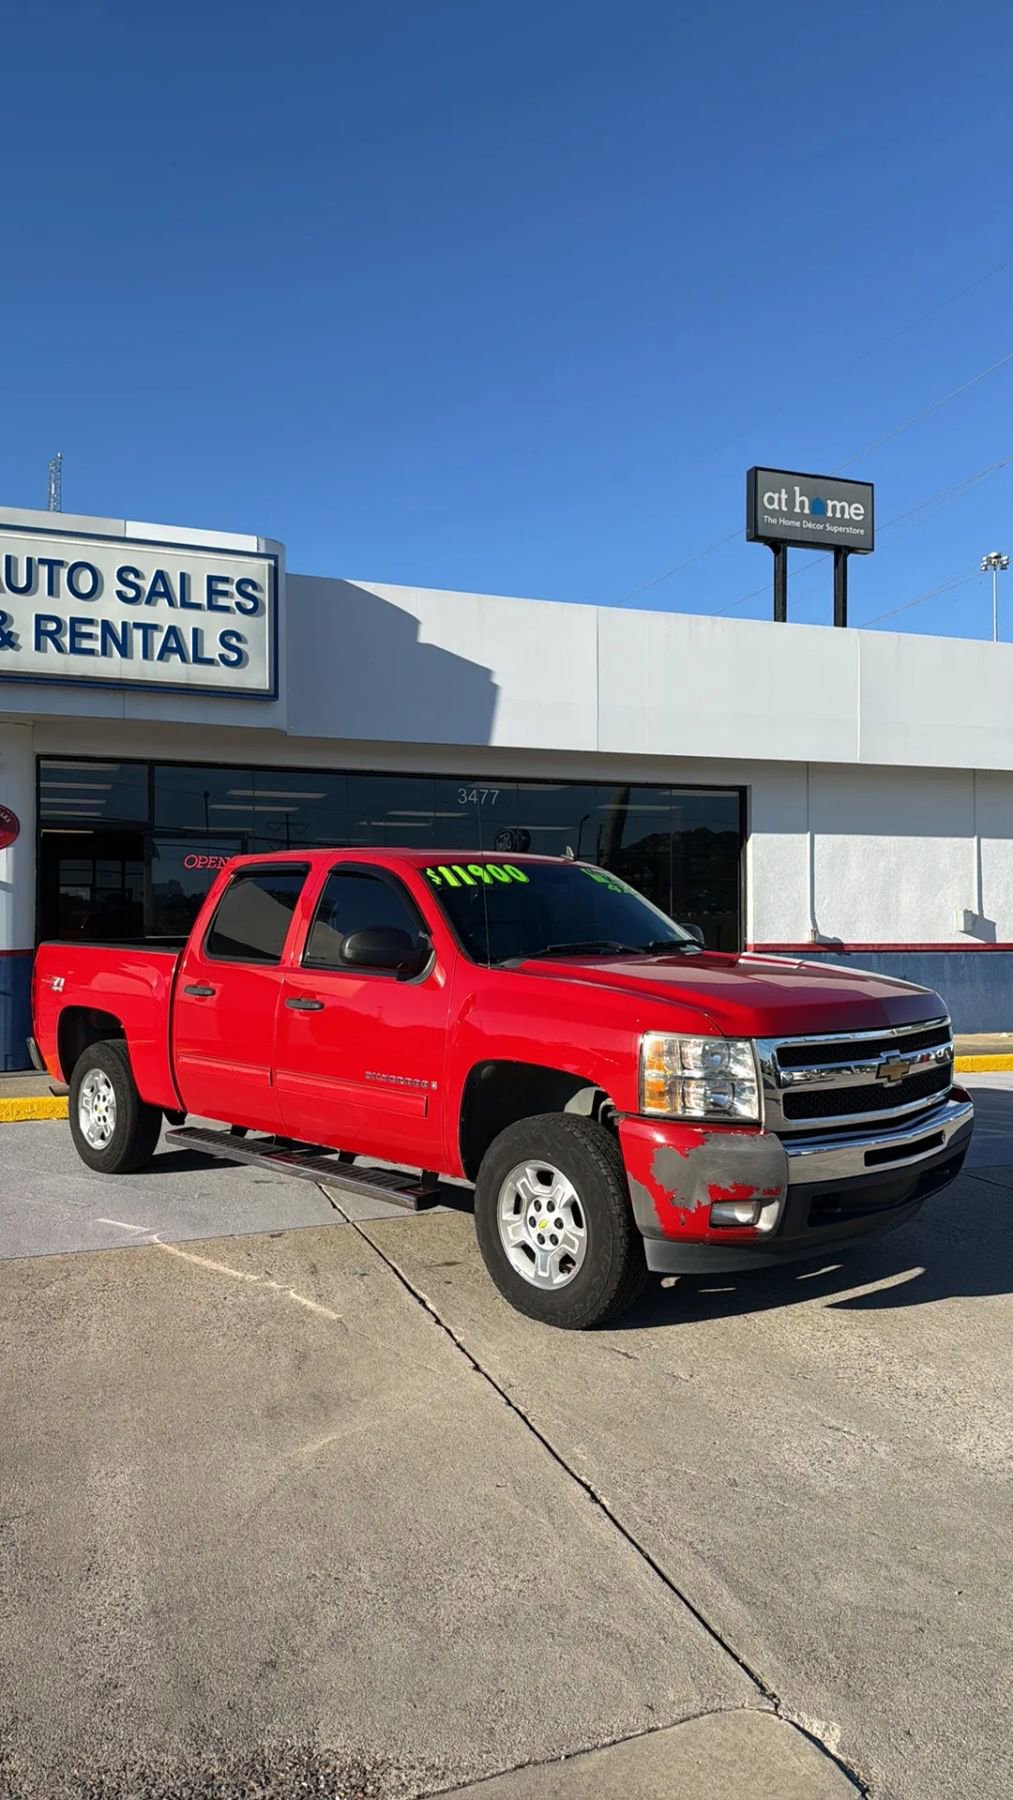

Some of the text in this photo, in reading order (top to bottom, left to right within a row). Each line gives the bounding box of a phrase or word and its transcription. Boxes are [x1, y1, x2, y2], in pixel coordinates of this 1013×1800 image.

[763, 486, 865, 520] at home
[763, 515, 865, 536] The Home Décor Superstore
[0, 554, 260, 616] UTO SALES
[34, 613, 244, 668] RENTALS
[457, 788, 500, 805] 3477
[184, 854, 231, 870] OPEN
[425, 863, 530, 888] $11900
